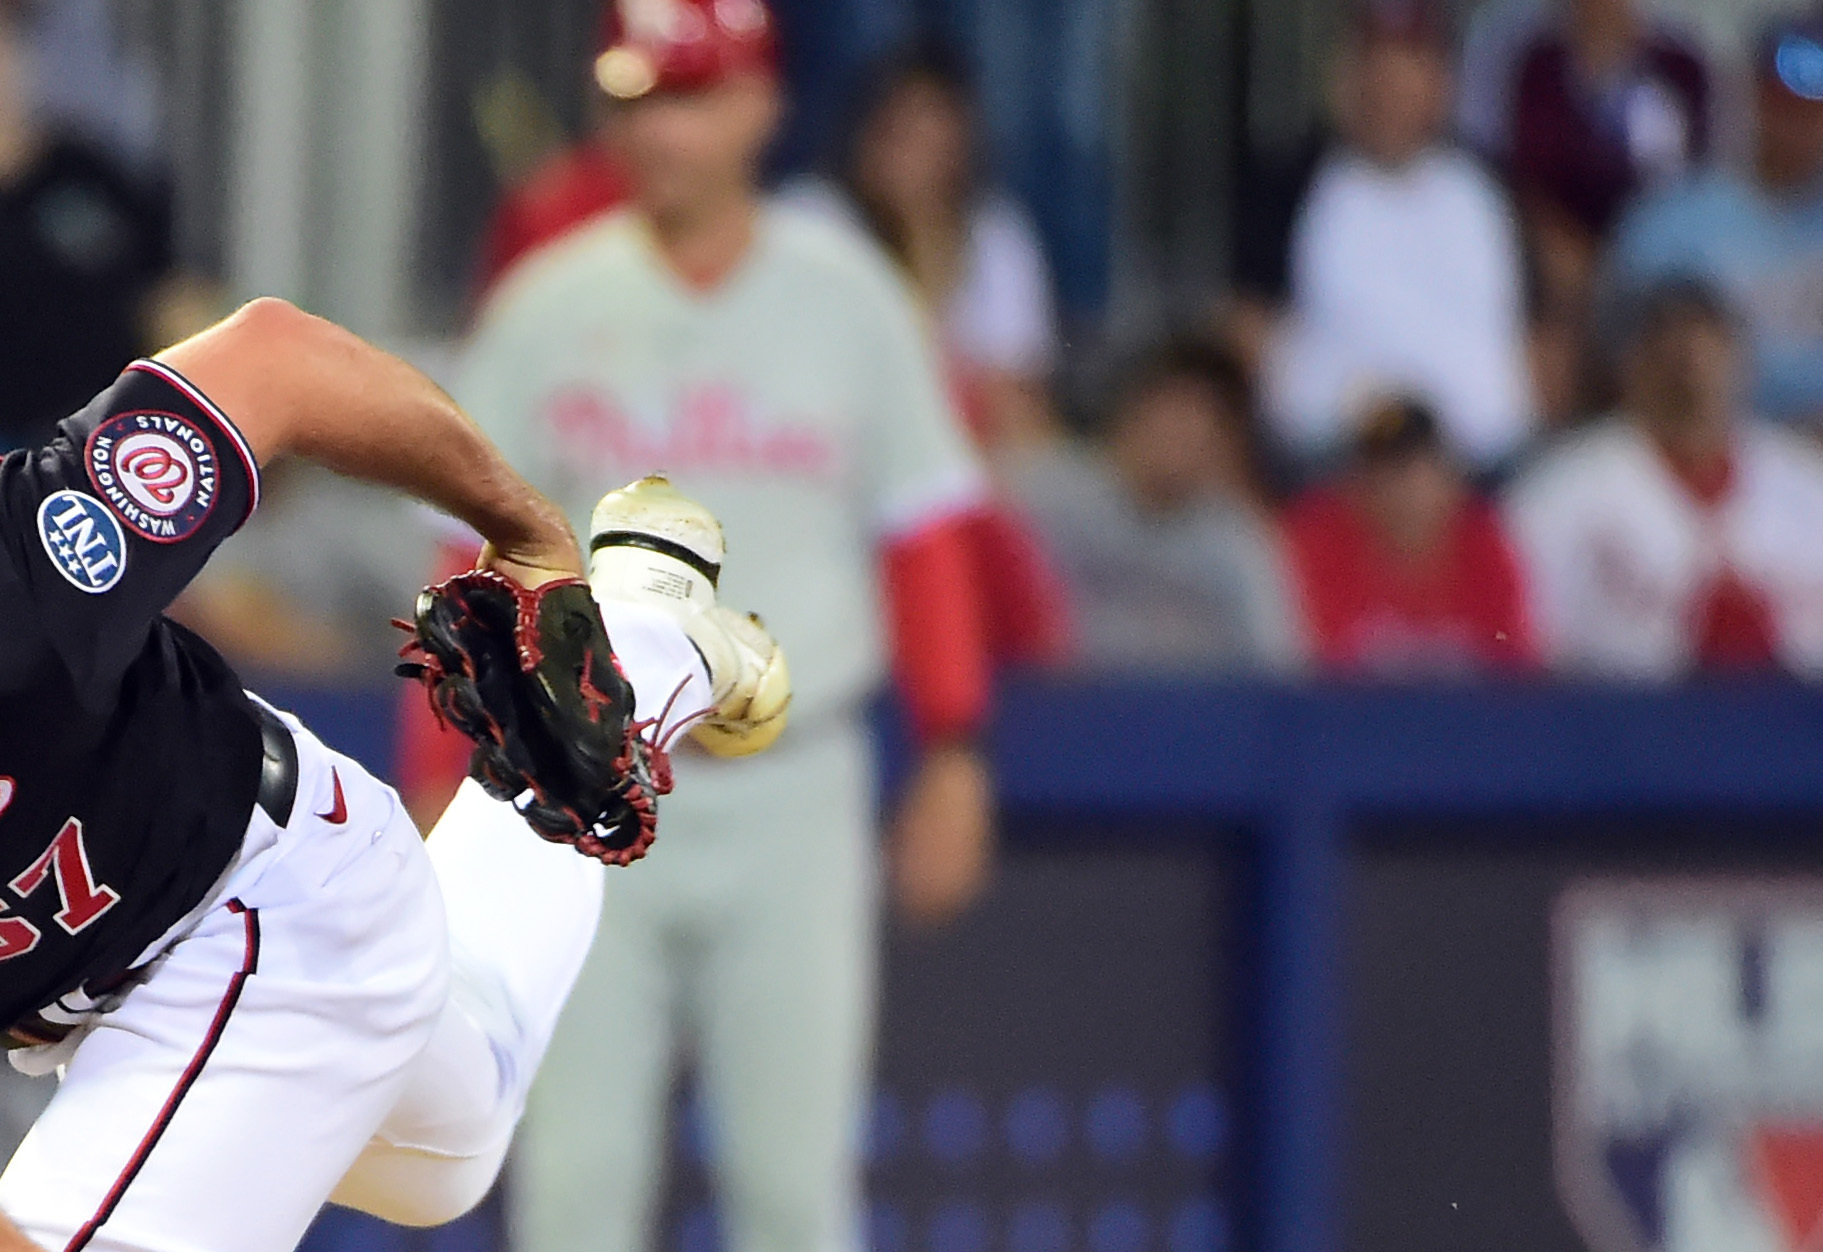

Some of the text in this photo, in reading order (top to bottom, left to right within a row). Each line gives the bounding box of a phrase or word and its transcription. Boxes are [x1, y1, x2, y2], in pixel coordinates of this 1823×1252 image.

[92, 435, 177, 536] WASHINGTON
[135, 415, 216, 508] NATIONALS
[51, 495, 119, 587] TNT
